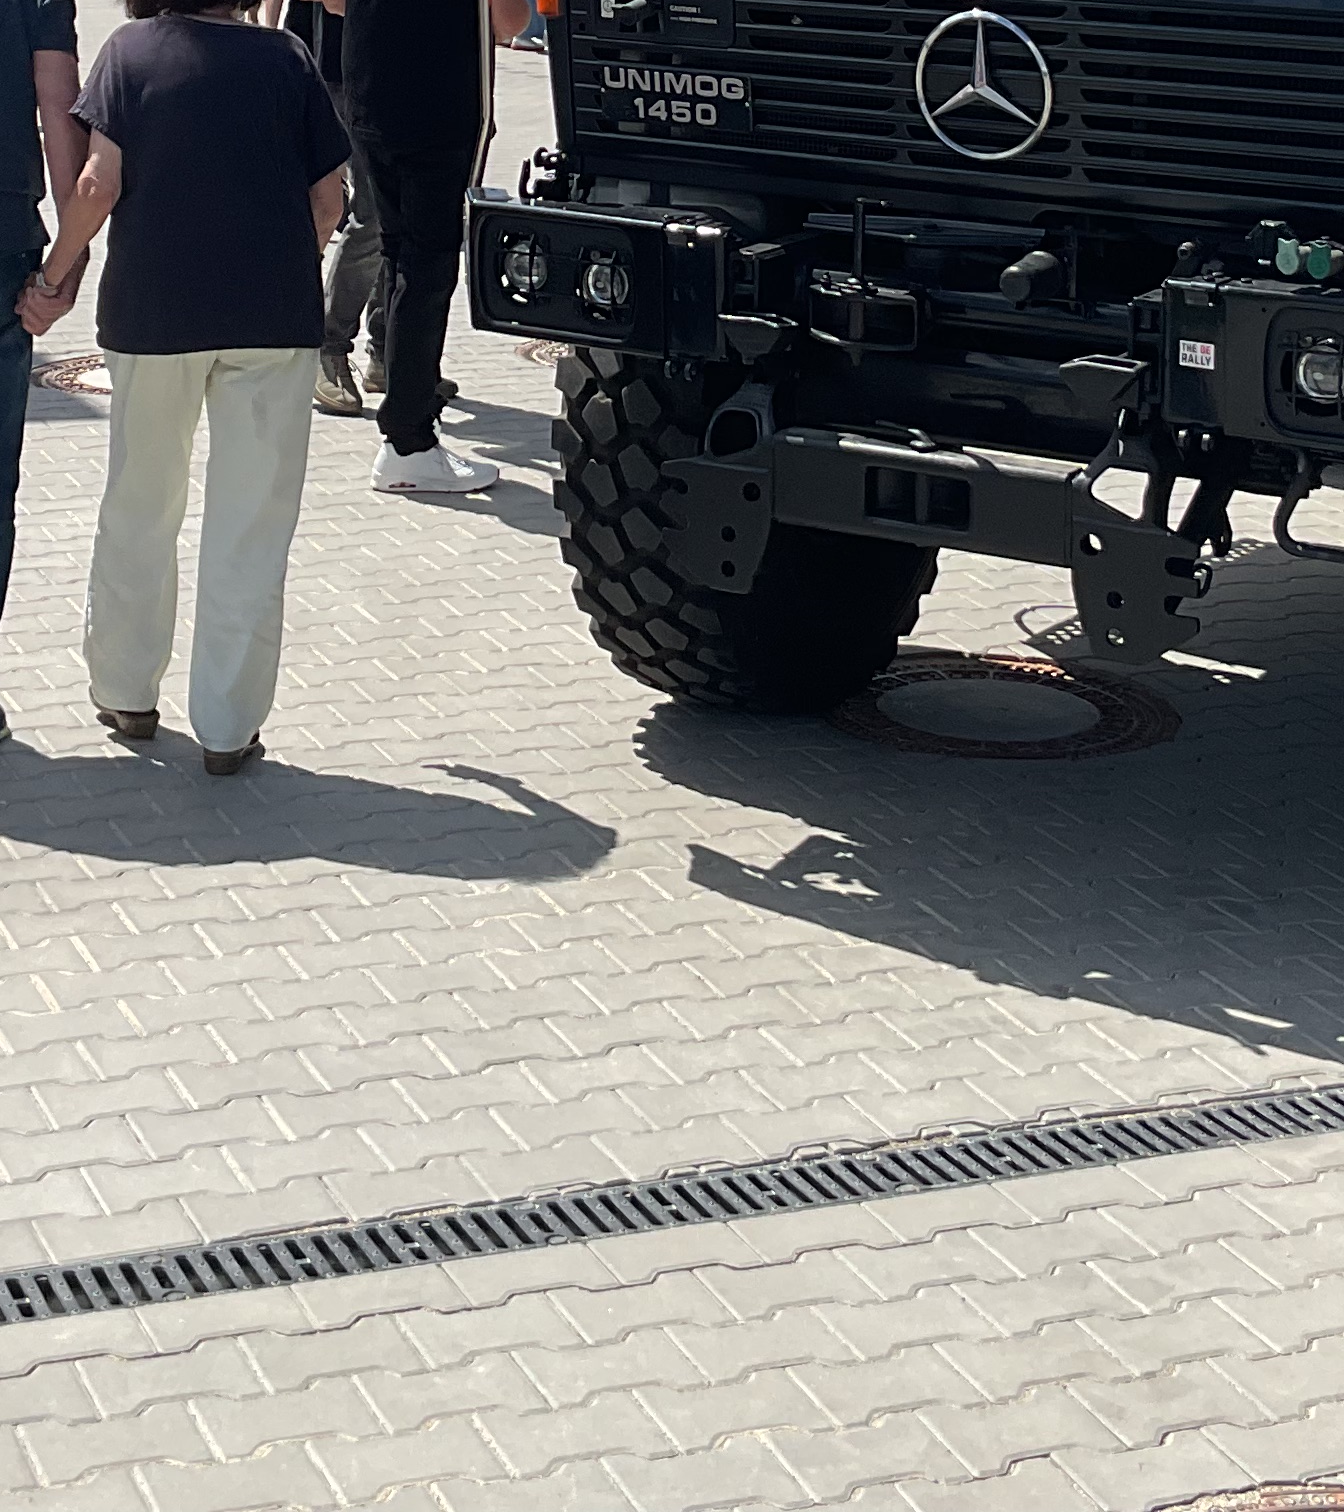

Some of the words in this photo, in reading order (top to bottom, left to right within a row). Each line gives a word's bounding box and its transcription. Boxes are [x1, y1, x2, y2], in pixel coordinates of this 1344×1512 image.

[603, 66, 745, 100] UNIMOG
[633, 97, 717, 126] 1450
[1182, 343, 1197, 353] THE
[1181, 353, 1211, 366] RALLY
